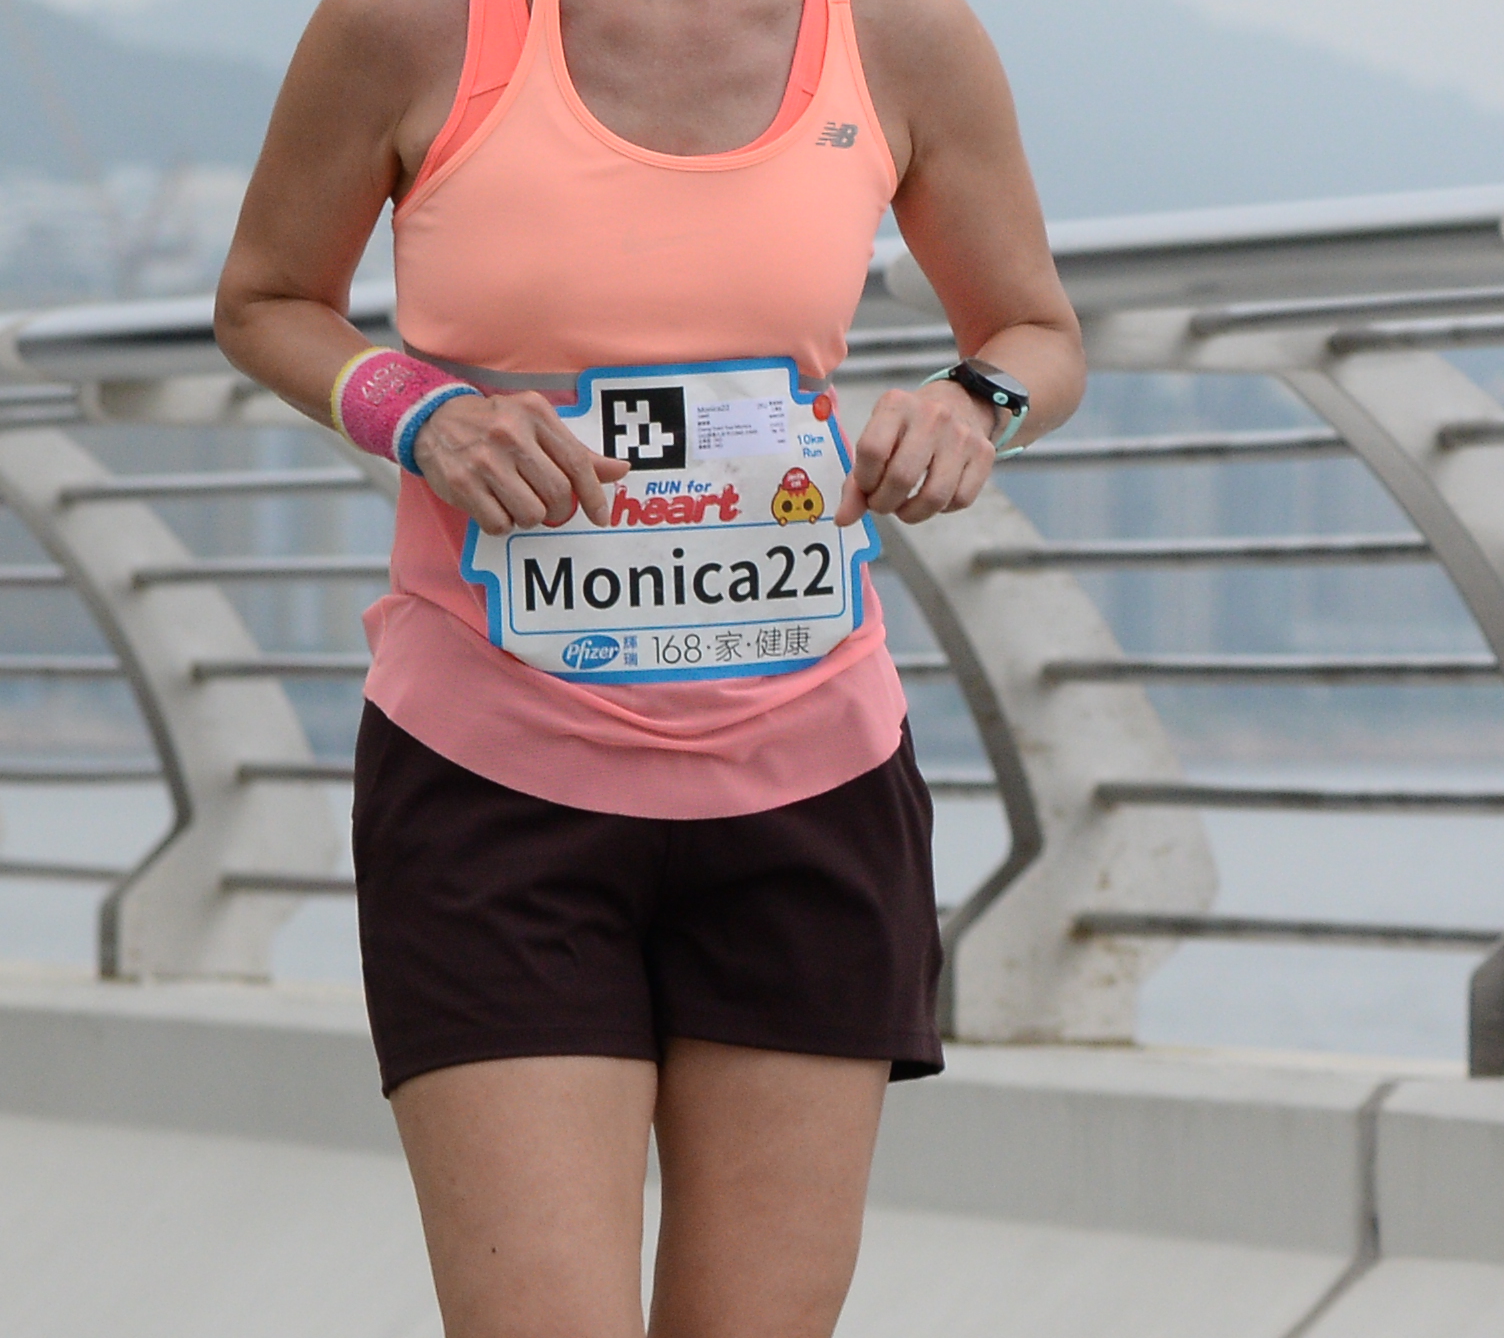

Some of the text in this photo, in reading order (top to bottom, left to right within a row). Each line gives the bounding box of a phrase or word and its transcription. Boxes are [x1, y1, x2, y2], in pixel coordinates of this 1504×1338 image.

[797, 434, 825, 445] 10km
[802, 448, 823, 458] Run
[645, 479, 711, 495] RUN for
[610, 482, 740, 527] heart
[523, 542, 834, 612] Monica22
[565, 639, 619, 670] Pfizer
